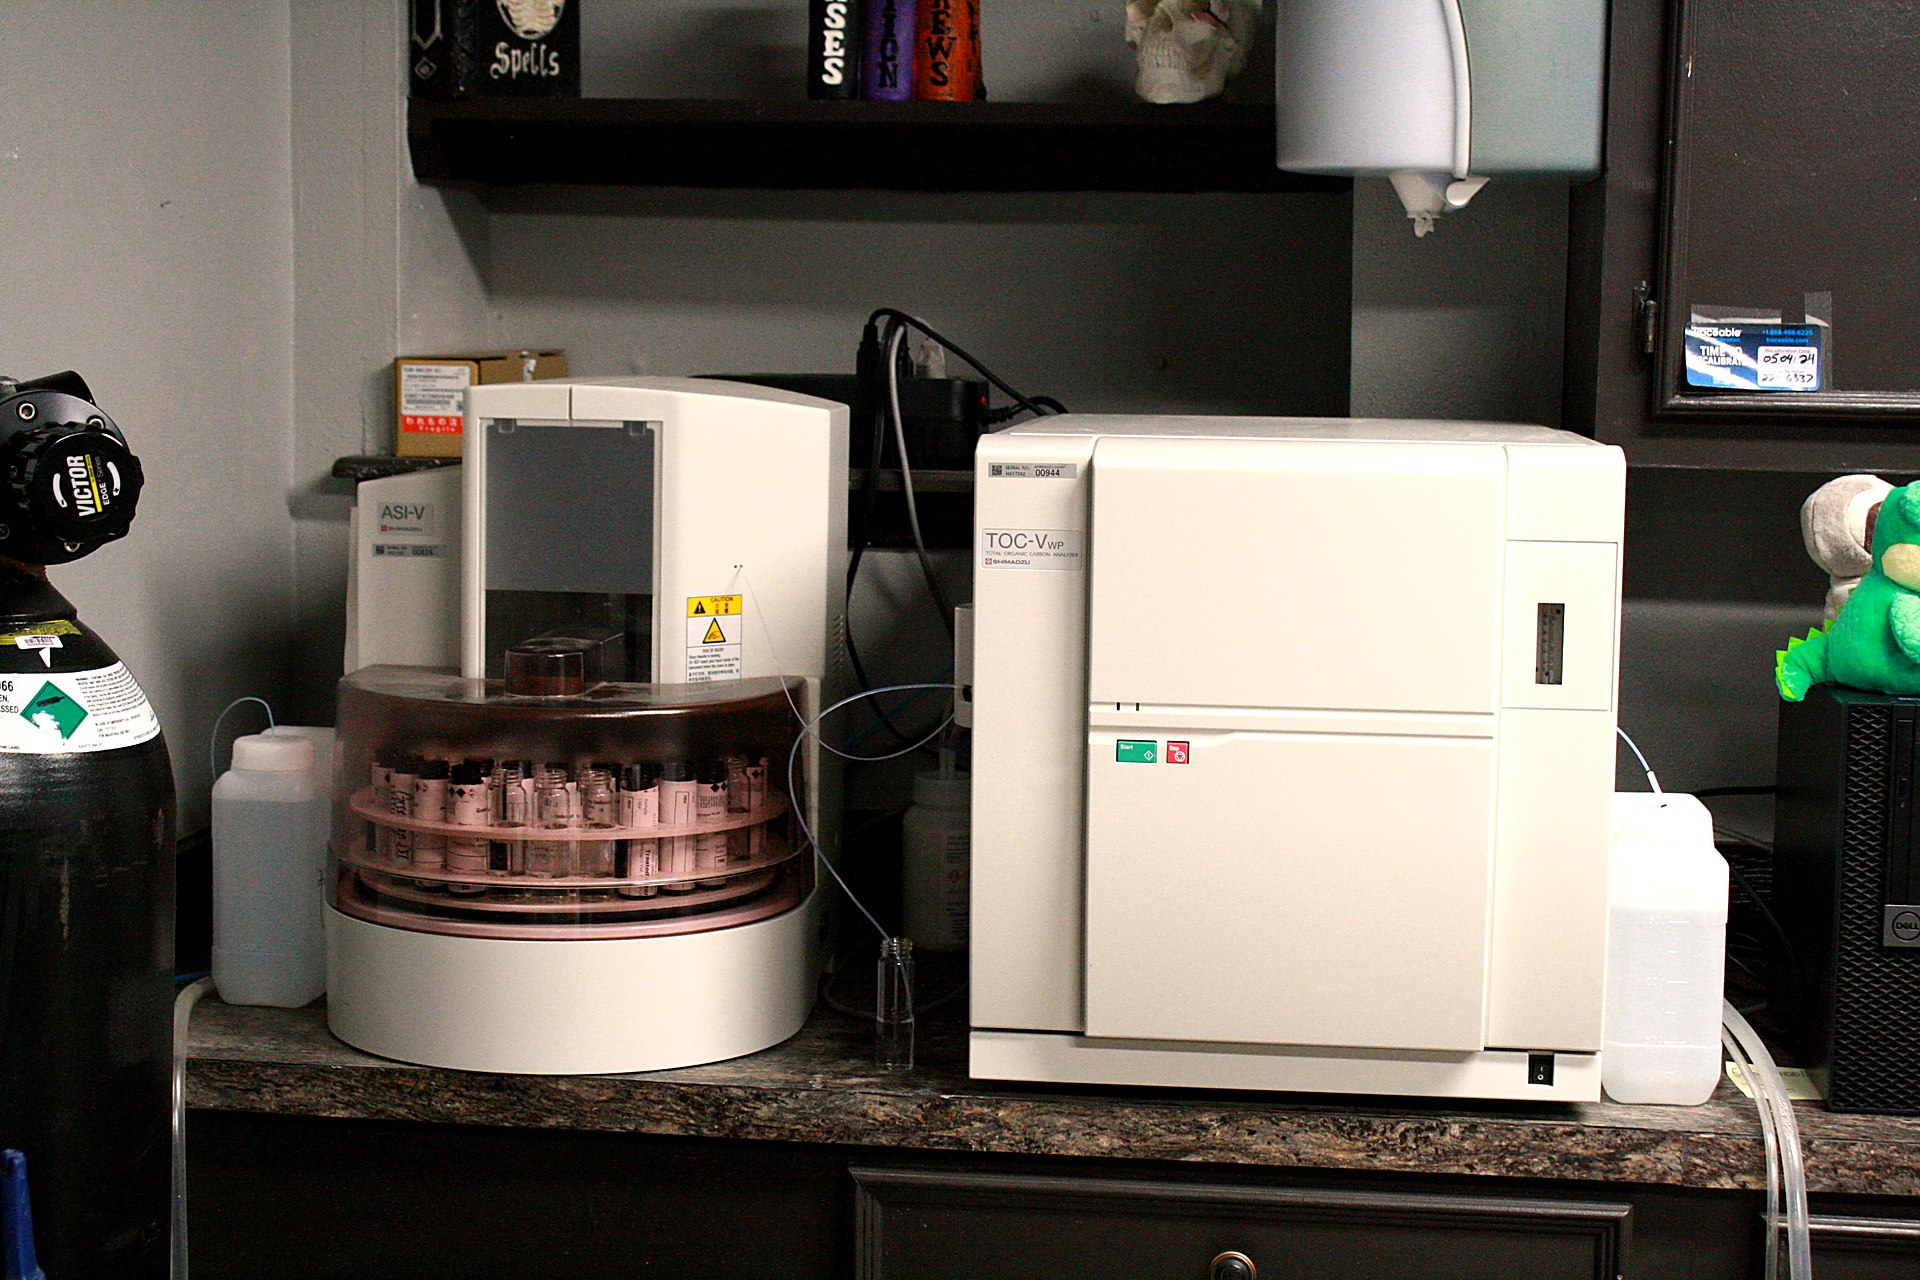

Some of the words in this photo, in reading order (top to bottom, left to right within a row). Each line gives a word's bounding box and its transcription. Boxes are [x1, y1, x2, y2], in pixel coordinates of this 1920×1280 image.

[822, 0, 848, 85] SES
[490, 41, 560, 80] Spells
[1035, 469, 1060, 477] 00944
[66, 455, 96, 517] VICTOR
[99, 482, 110, 505] EDGE
[381, 505, 425, 520] ASI-V
[0, 704, 19, 714] SSED
[1895, 922, 1920, 930] DELL
